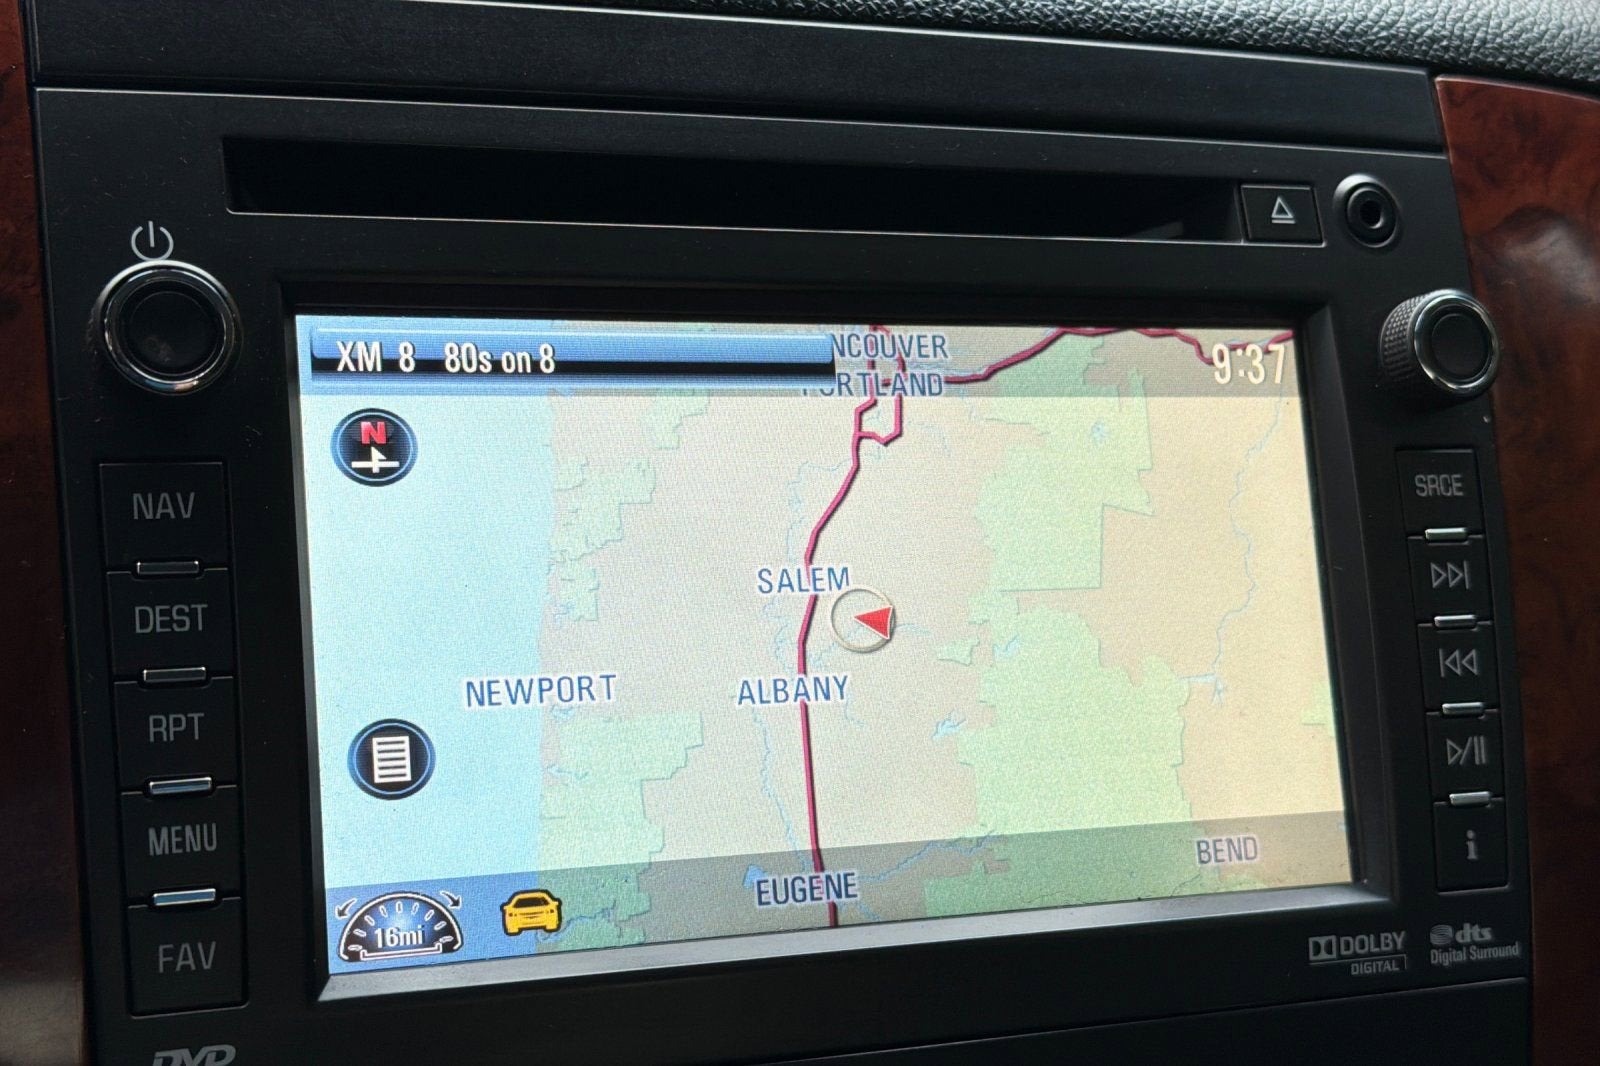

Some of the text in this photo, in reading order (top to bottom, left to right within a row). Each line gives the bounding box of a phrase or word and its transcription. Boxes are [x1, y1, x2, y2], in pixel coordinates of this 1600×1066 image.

[337, 341, 556, 374] XM 8 80s on 8
[1212, 343, 1285, 384] 9:37
[802, 372, 943, 397] RTLAND
[360, 420, 387, 445] N
[1415, 473, 1464, 498] SRCE
[132, 491, 196, 520] NAV
[757, 566, 850, 594] SALEM
[134, 603, 209, 634] DEST
[465, 673, 618, 708] NEWPORT
[737, 674, 849, 706] ALBANY
[149, 712, 205, 743] RPT
[148, 822, 218, 857] MENU
[1196, 836, 1259, 865] BEND
[755, 871, 858, 907] EUGENE
[374, 925, 425, 949] 16mi
[1339, 930, 1406, 956] DOLBY
[1455, 923, 1493, 944] dts
[158, 941, 217, 973] FAV
[1351, 960, 1400, 975] DIGITAL
[1430, 940, 1521, 967] Digital Surround
[151, 1044, 237, 1066] DVD
